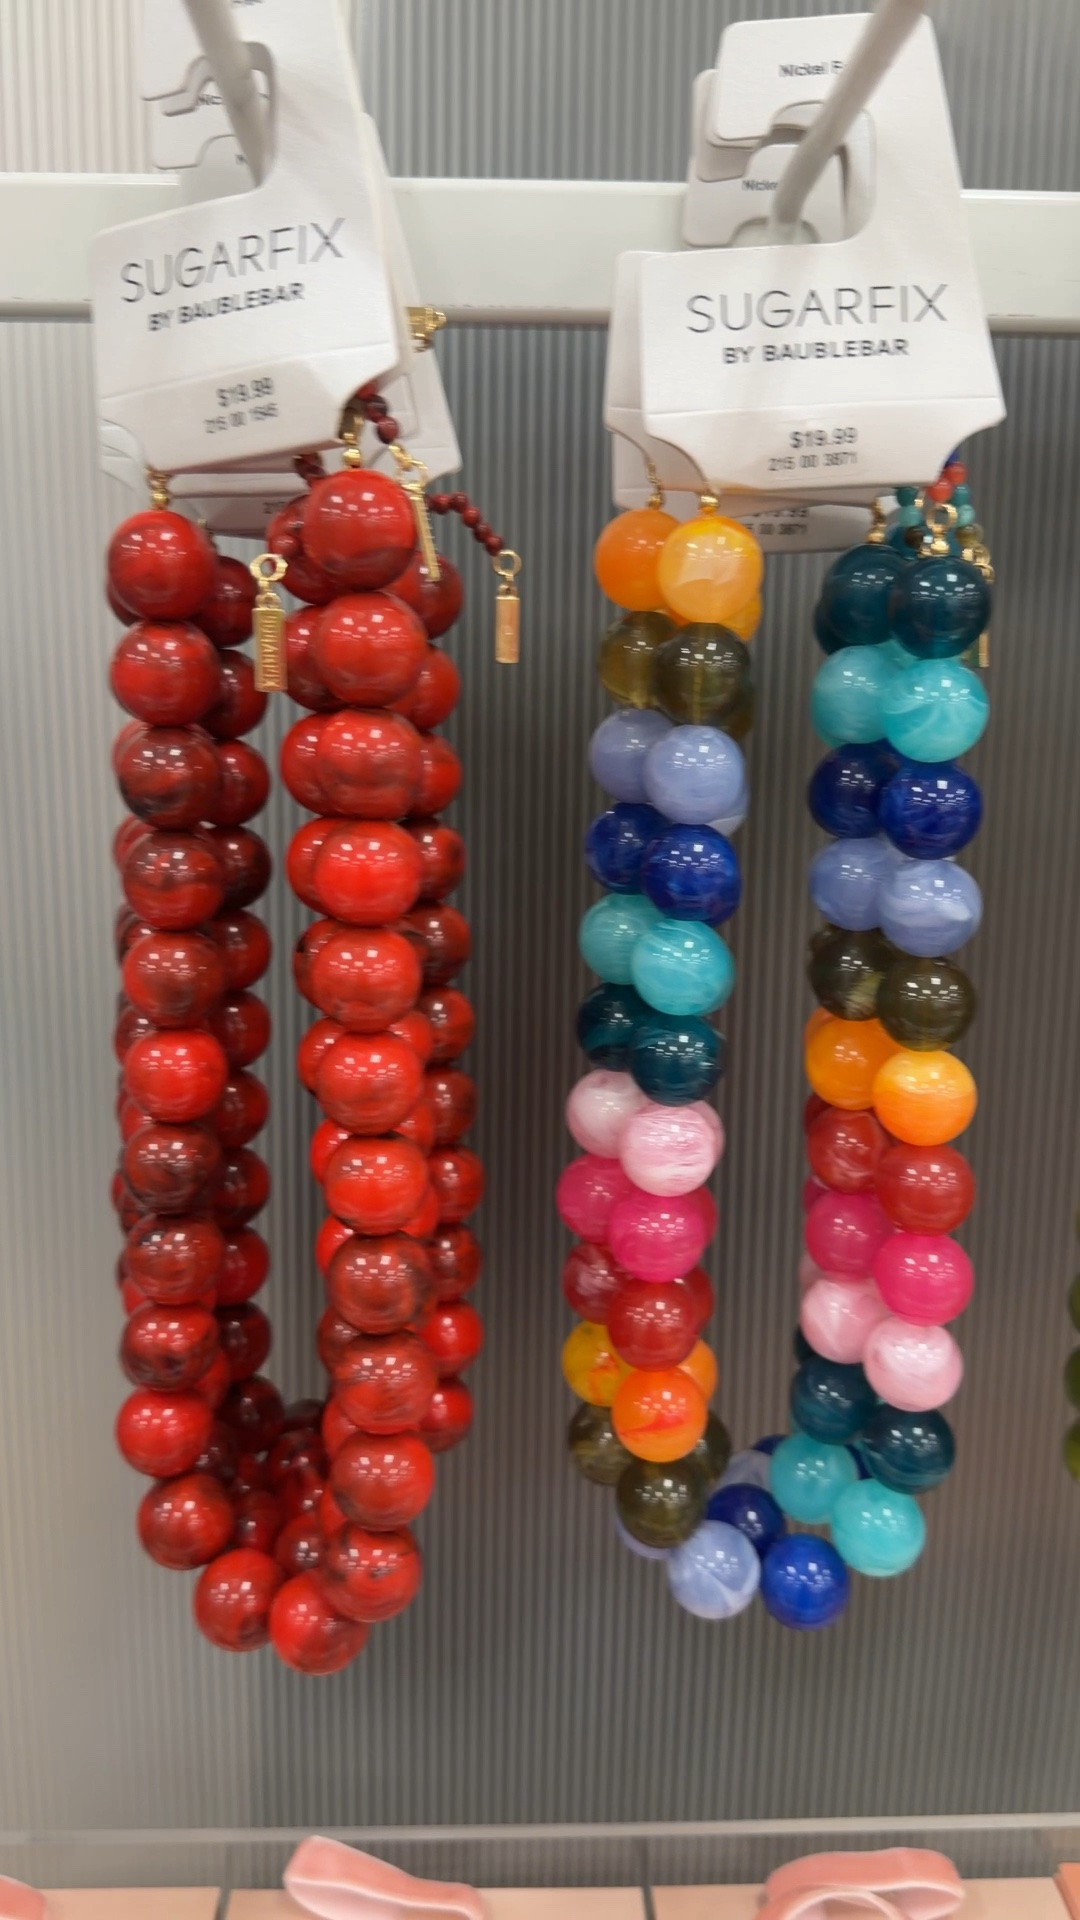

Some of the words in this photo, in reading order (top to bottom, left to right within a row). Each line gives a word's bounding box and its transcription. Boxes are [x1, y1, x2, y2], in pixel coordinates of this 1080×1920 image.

[779, 62, 828, 77] Nickel
[120, 217, 345, 303] SUGARFIX
[147, 309, 174, 331] BY
[177, 283, 304, 323] BAUBLEBAR
[686, 283, 949, 333] SUGARFIX
[722, 346, 755, 364] BY
[762, 338, 910, 361] BAUBLEBAR
[216, 377, 274, 407] $19.99
[204, 416, 228, 433] 215
[789, 426, 858, 449] $19.99
[767, 456, 795, 471] 215
[799, 454, 819, 468] 00
